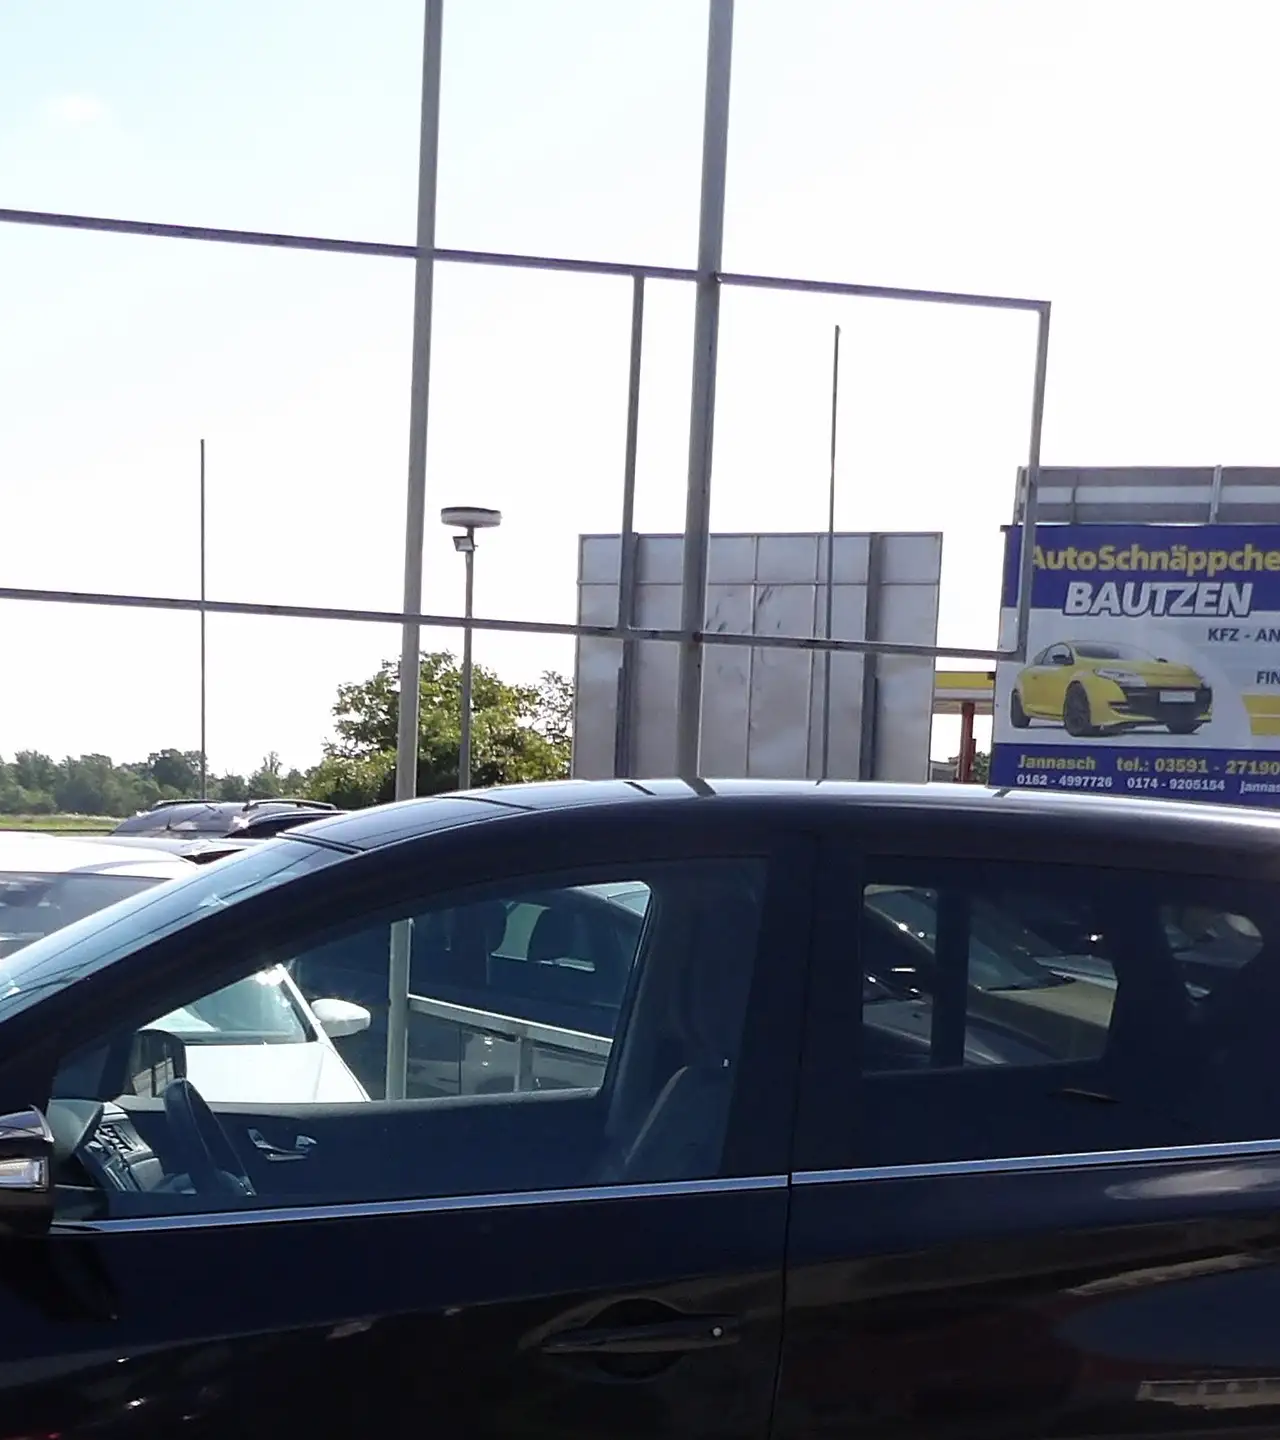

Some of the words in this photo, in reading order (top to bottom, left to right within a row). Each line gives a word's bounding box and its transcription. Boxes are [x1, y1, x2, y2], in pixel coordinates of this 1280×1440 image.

[1063, 580, 1253, 617] BAUTZEN
[1207, 627, 1240, 642] KFZ
[1017, 754, 1097, 771] Jannasch
[1154, 758, 1209, 774] 03591
[1126, 776, 1159, 789] 0174
